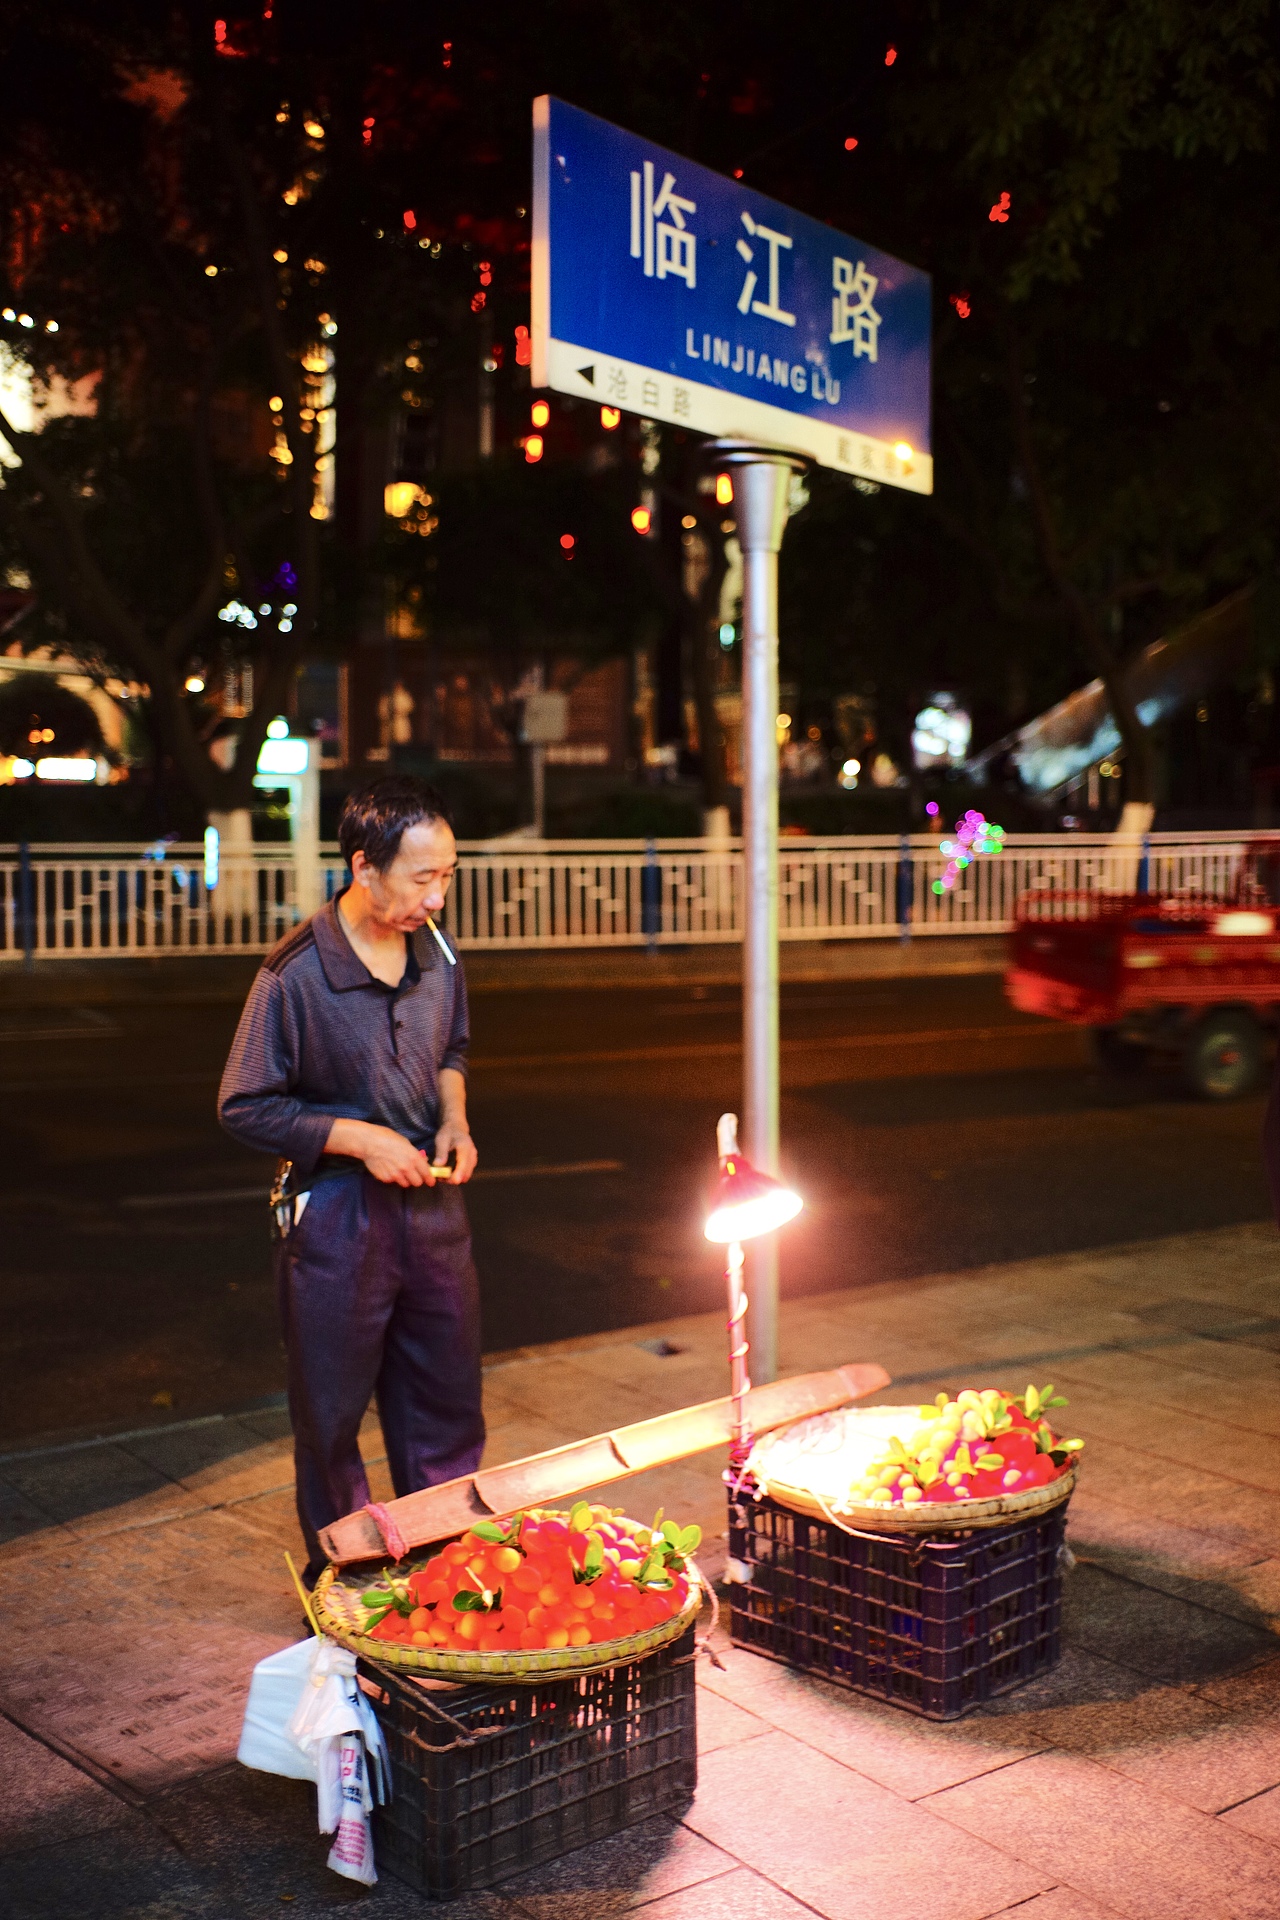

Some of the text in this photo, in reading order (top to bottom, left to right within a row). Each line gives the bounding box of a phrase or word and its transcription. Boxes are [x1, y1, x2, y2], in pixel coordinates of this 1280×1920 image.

[630, 160, 882, 363] 临江路
[686, 327, 841, 405] LINJIANG LU
